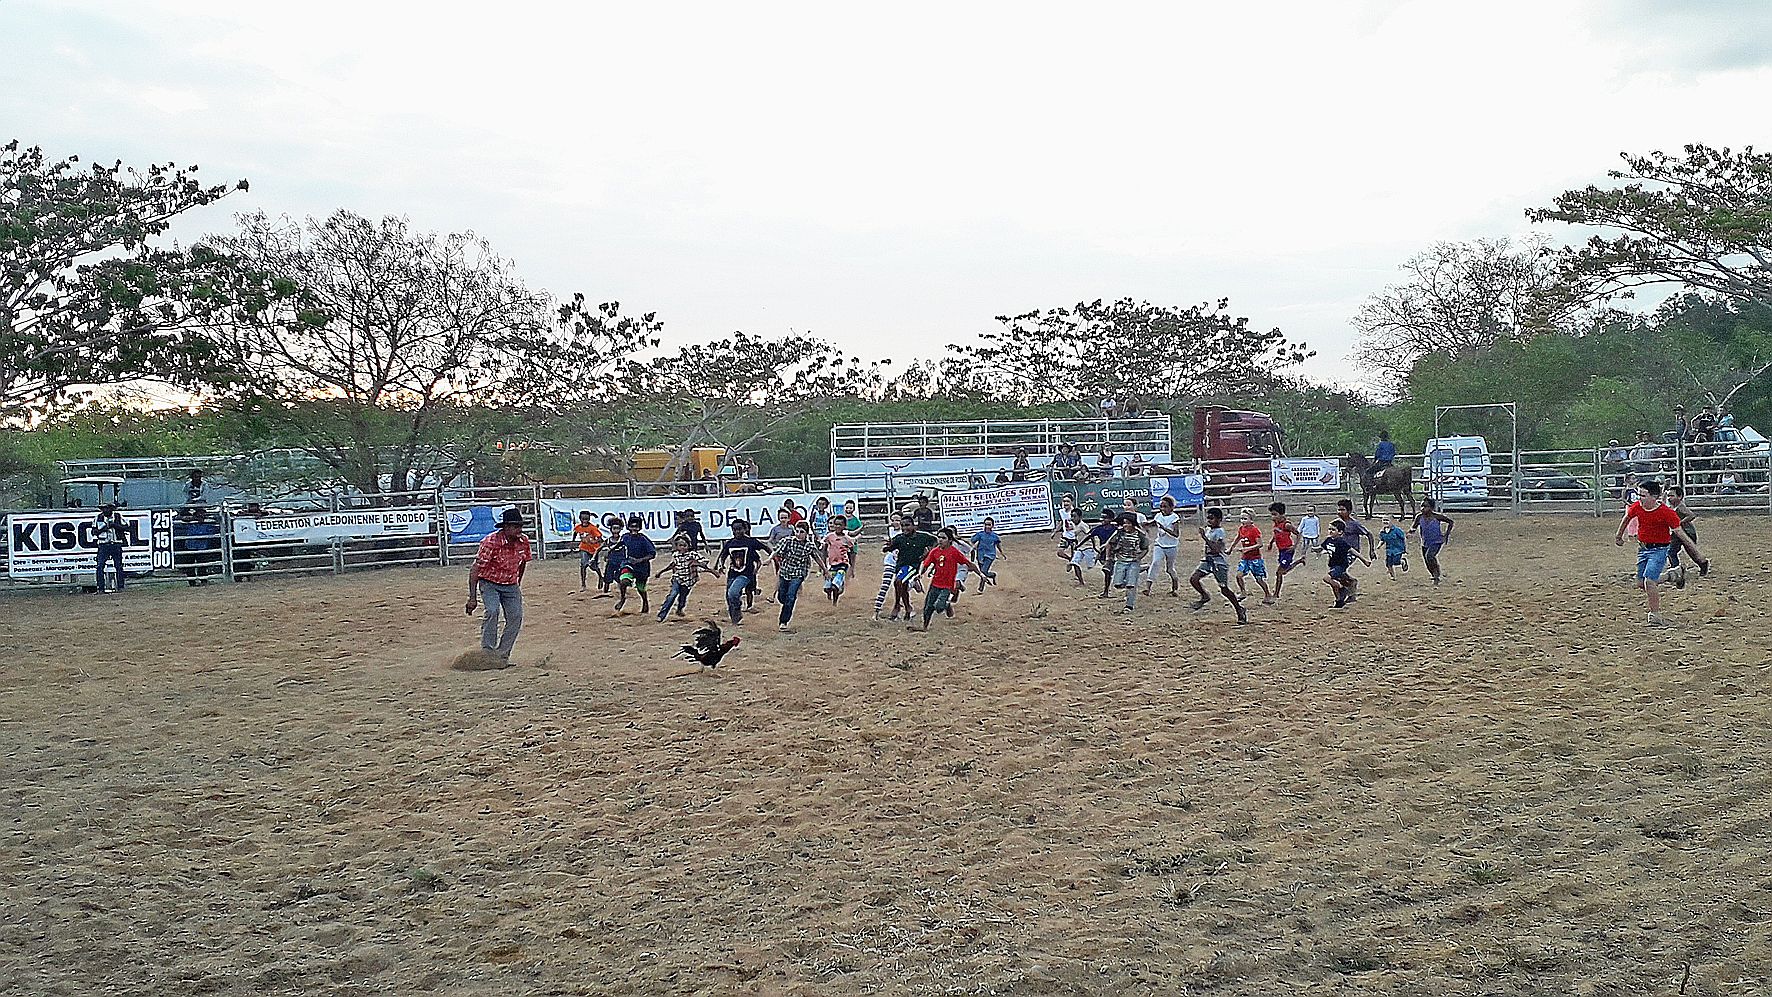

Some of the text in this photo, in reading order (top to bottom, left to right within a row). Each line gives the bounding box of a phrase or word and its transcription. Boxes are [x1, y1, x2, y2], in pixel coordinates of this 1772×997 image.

[973, 489, 1017, 501] SERVICES
[1018, 487, 1045, 496] SHOP
[1101, 488, 1149, 499] Groupama
[152, 512, 170, 529] 25
[255, 512, 425, 531] FEDERATION CALEDONIENNE DE RODEO
[710, 508, 738, 529] DE
[746, 507, 774, 525] LA
[12, 519, 149, 552] KISCL
[153, 531, 170, 548] 15
[153, 550, 170, 568] 00
